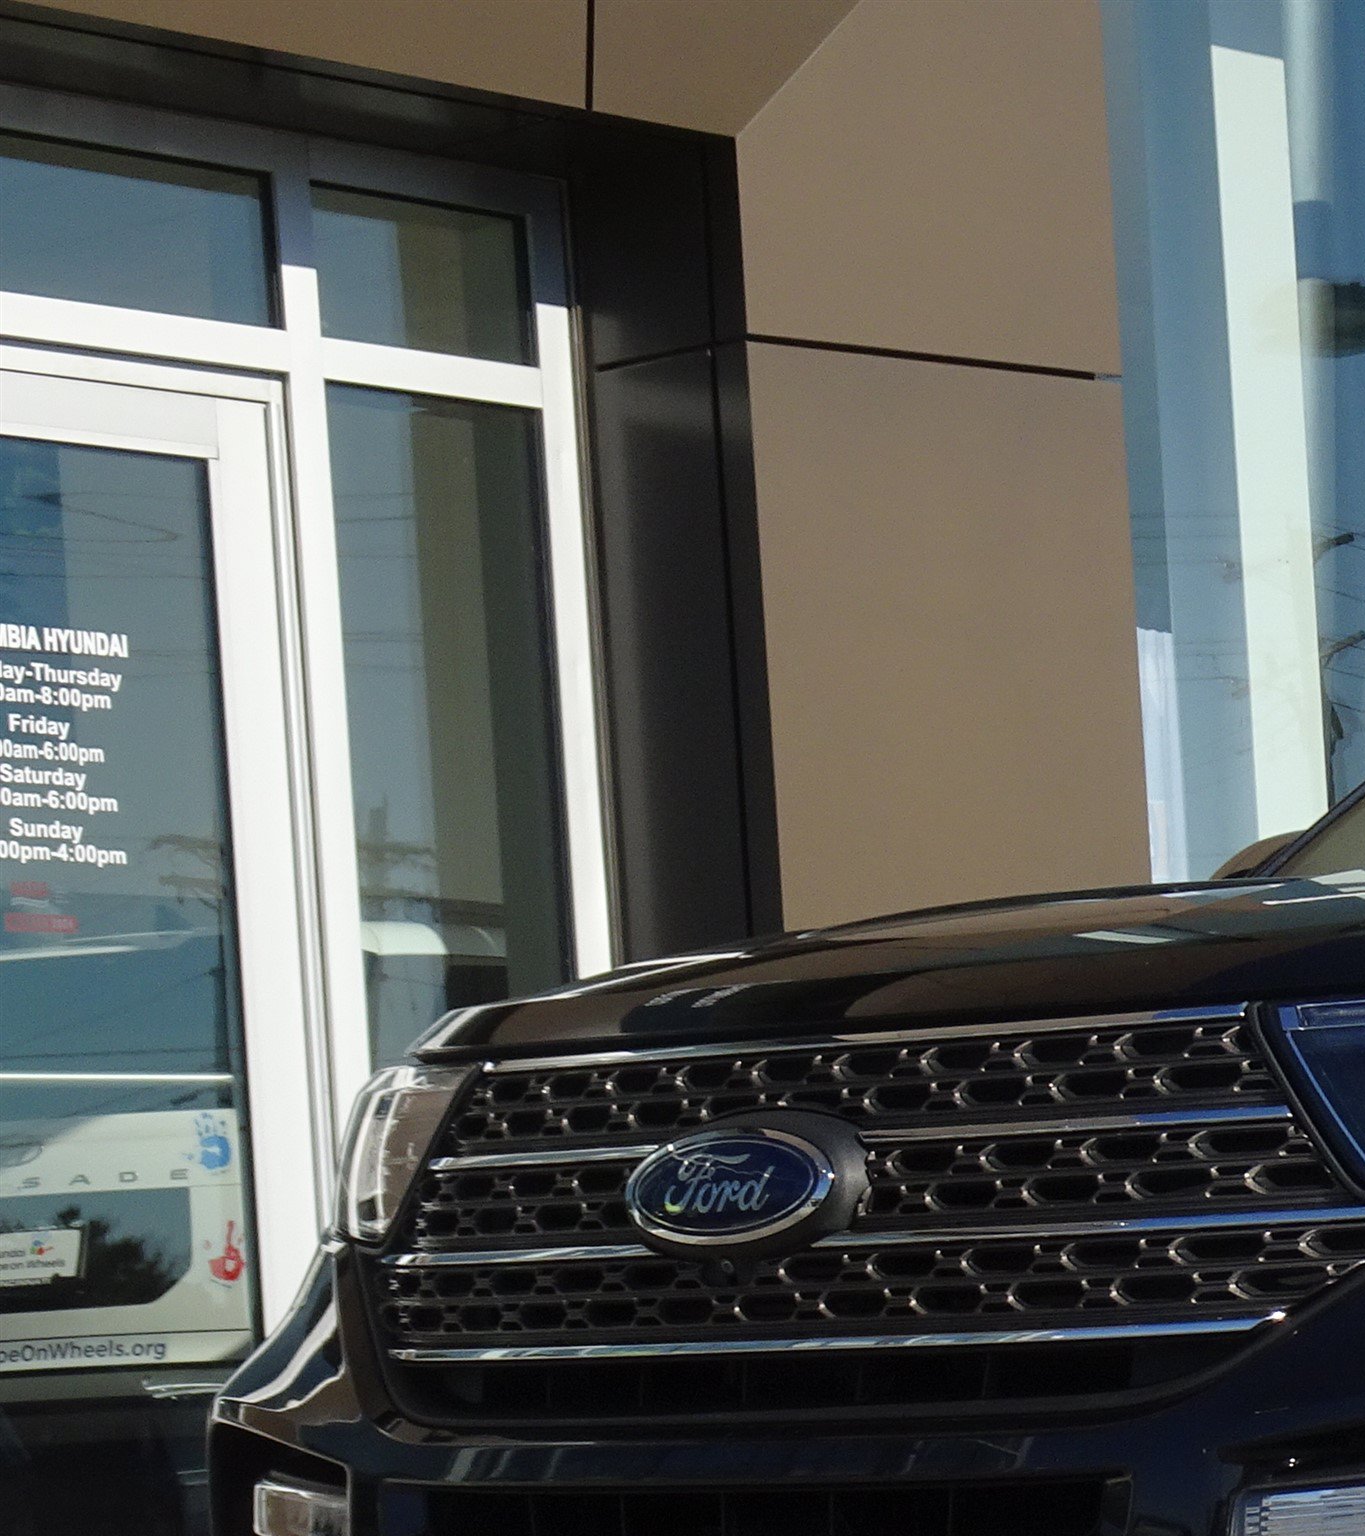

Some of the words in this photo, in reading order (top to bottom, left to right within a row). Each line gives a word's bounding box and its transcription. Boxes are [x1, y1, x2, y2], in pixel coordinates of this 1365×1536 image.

[43, 627, 129, 658] HYUNDAI
[0, 661, 122, 692] ay-Thursday
[8, 713, 70, 740] Friday
[0, 739, 105, 766] 0am-6:00pm
[0, 763, 87, 791] Saturday
[9, 817, 83, 844] Sunday
[663, 1151, 777, 1214] Ford
